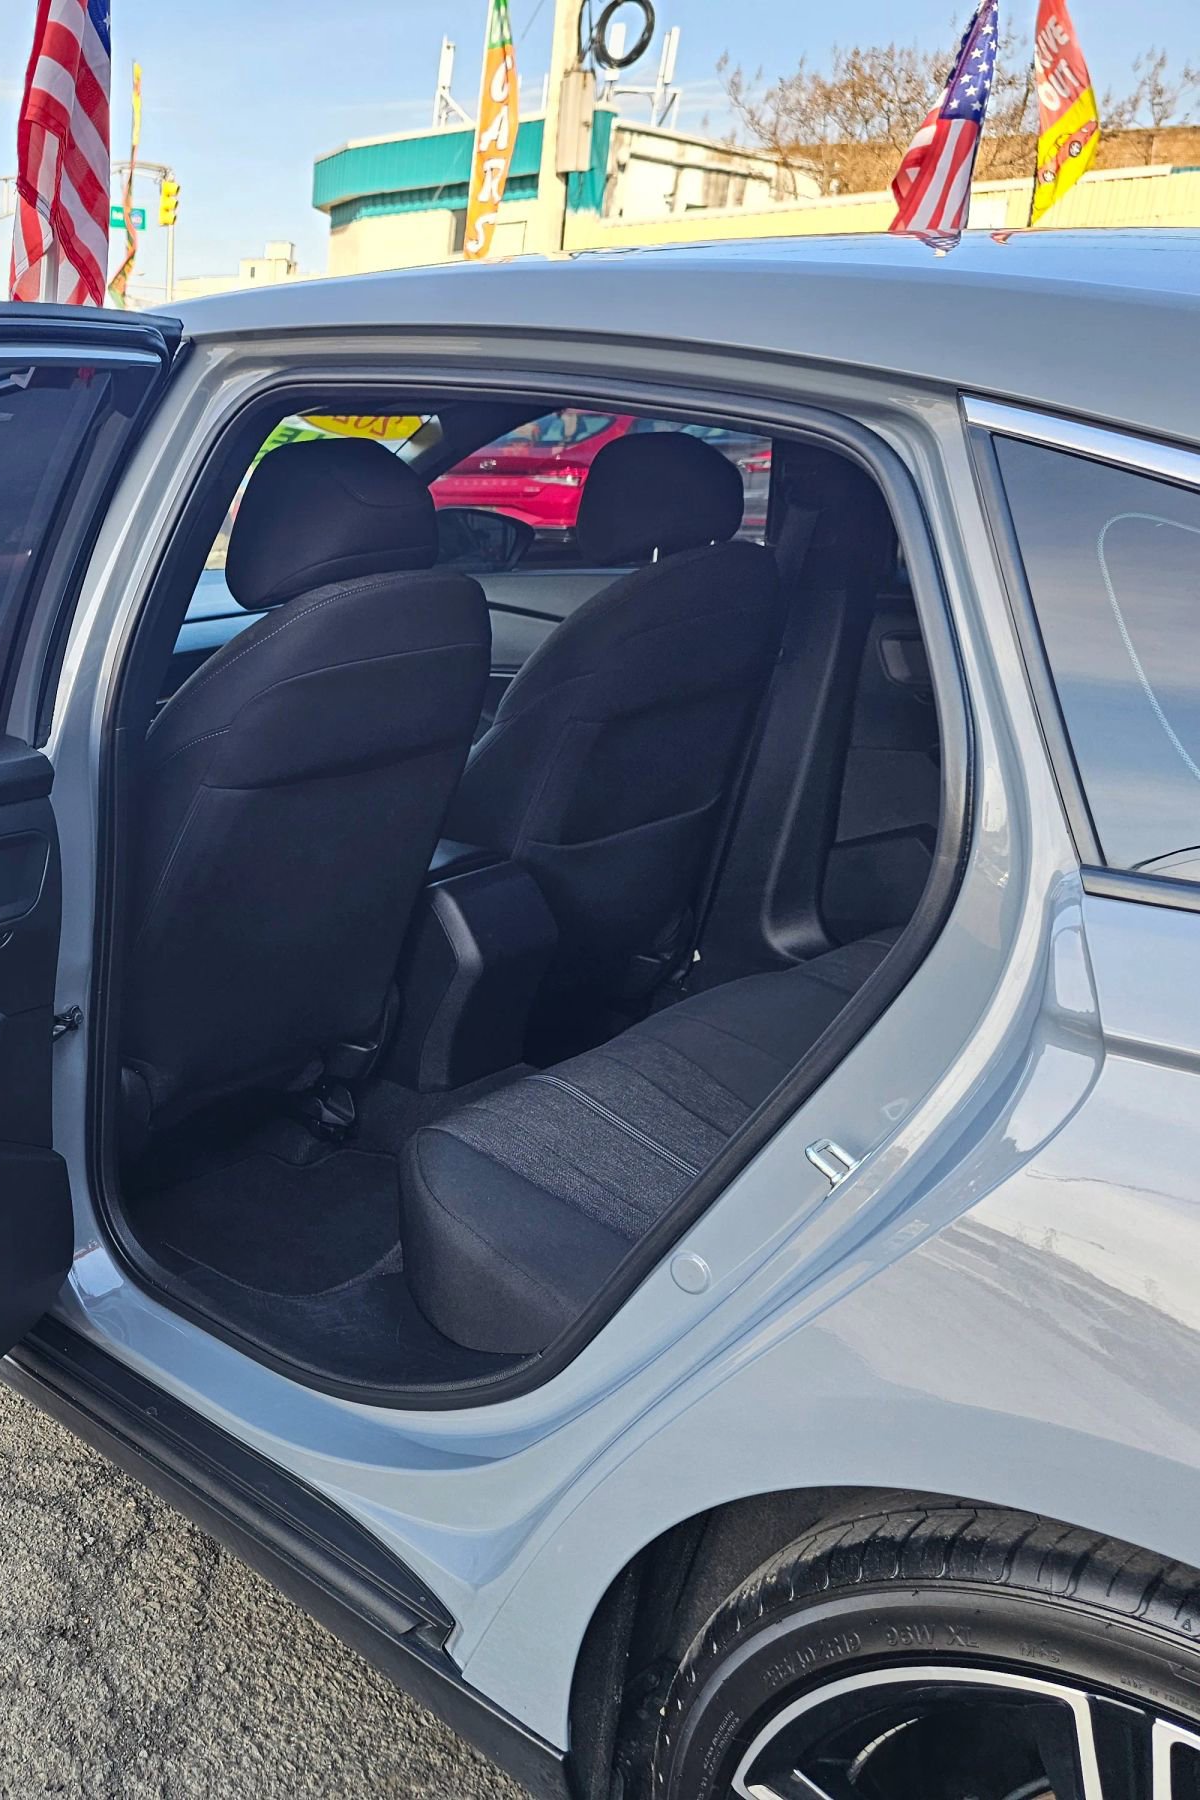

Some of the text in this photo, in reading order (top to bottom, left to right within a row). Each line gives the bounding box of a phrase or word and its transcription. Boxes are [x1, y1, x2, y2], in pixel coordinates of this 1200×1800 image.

[1037, 58, 1080, 113] OUT
[465, 54, 514, 254] CARS
[947, 1624, 980, 1649] XL
